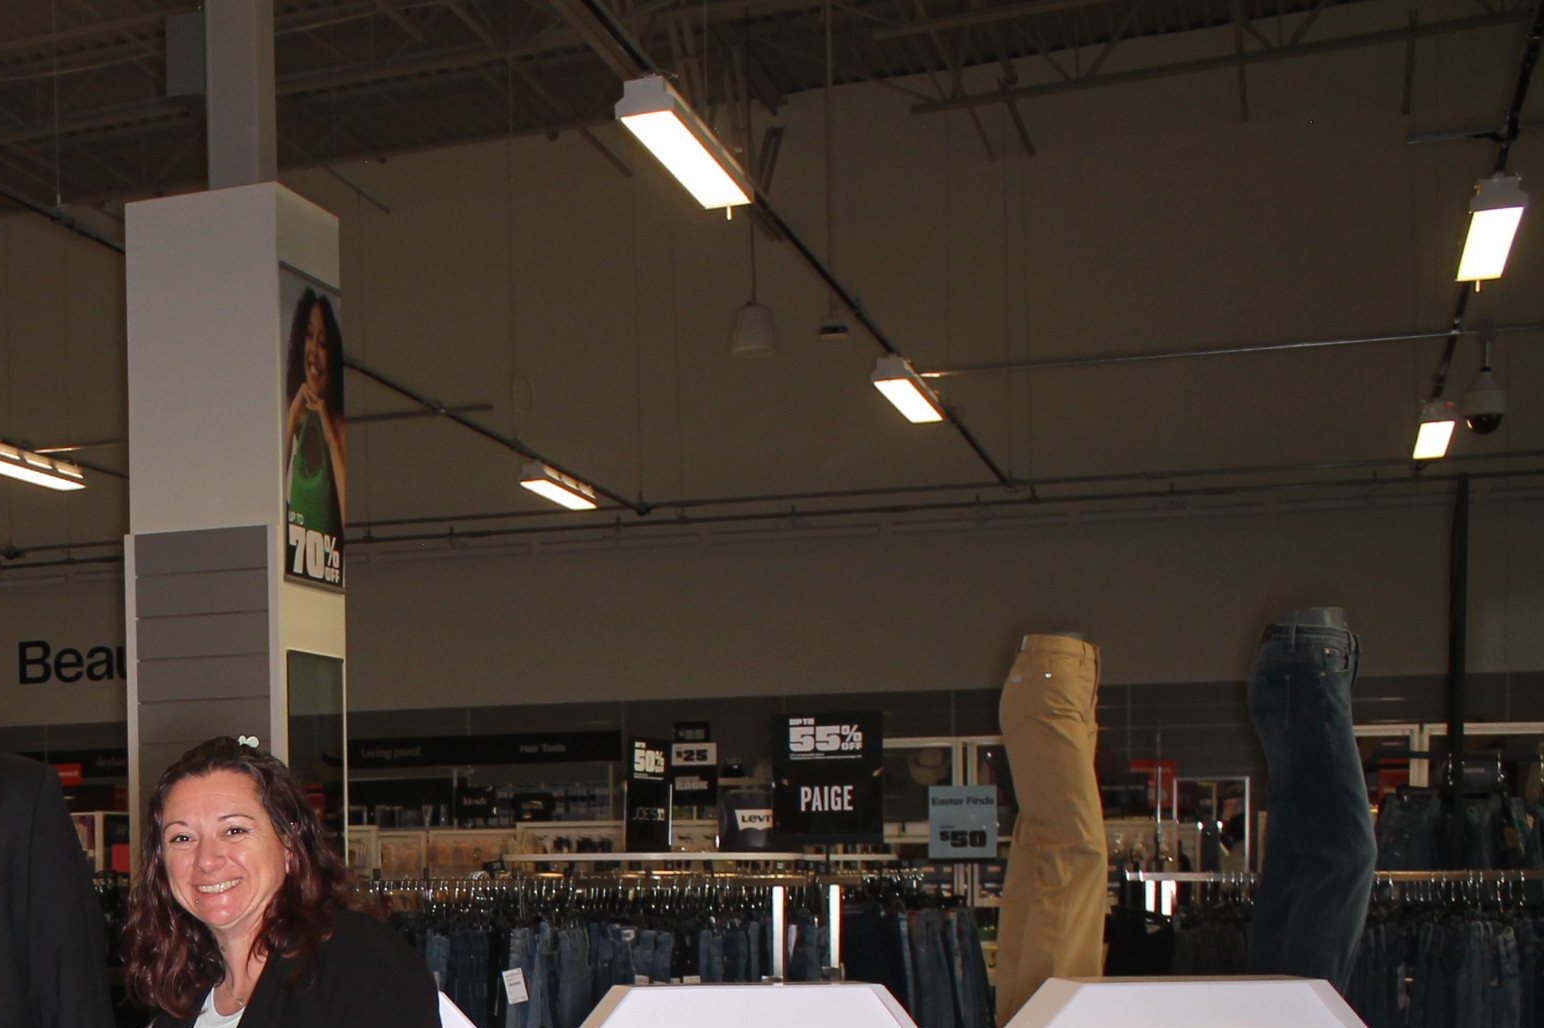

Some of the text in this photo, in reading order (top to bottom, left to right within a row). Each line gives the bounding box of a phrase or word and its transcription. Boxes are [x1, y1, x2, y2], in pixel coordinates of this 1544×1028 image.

[288, 523, 341, 579] 70%
[325, 566, 342, 584] OFF
[789, 724, 863, 752] 55%
[841, 741, 863, 751] OFF
[541, 742, 567, 753] Tools
[800, 784, 854, 812] PAIGE
[940, 830, 987, 848] $50
